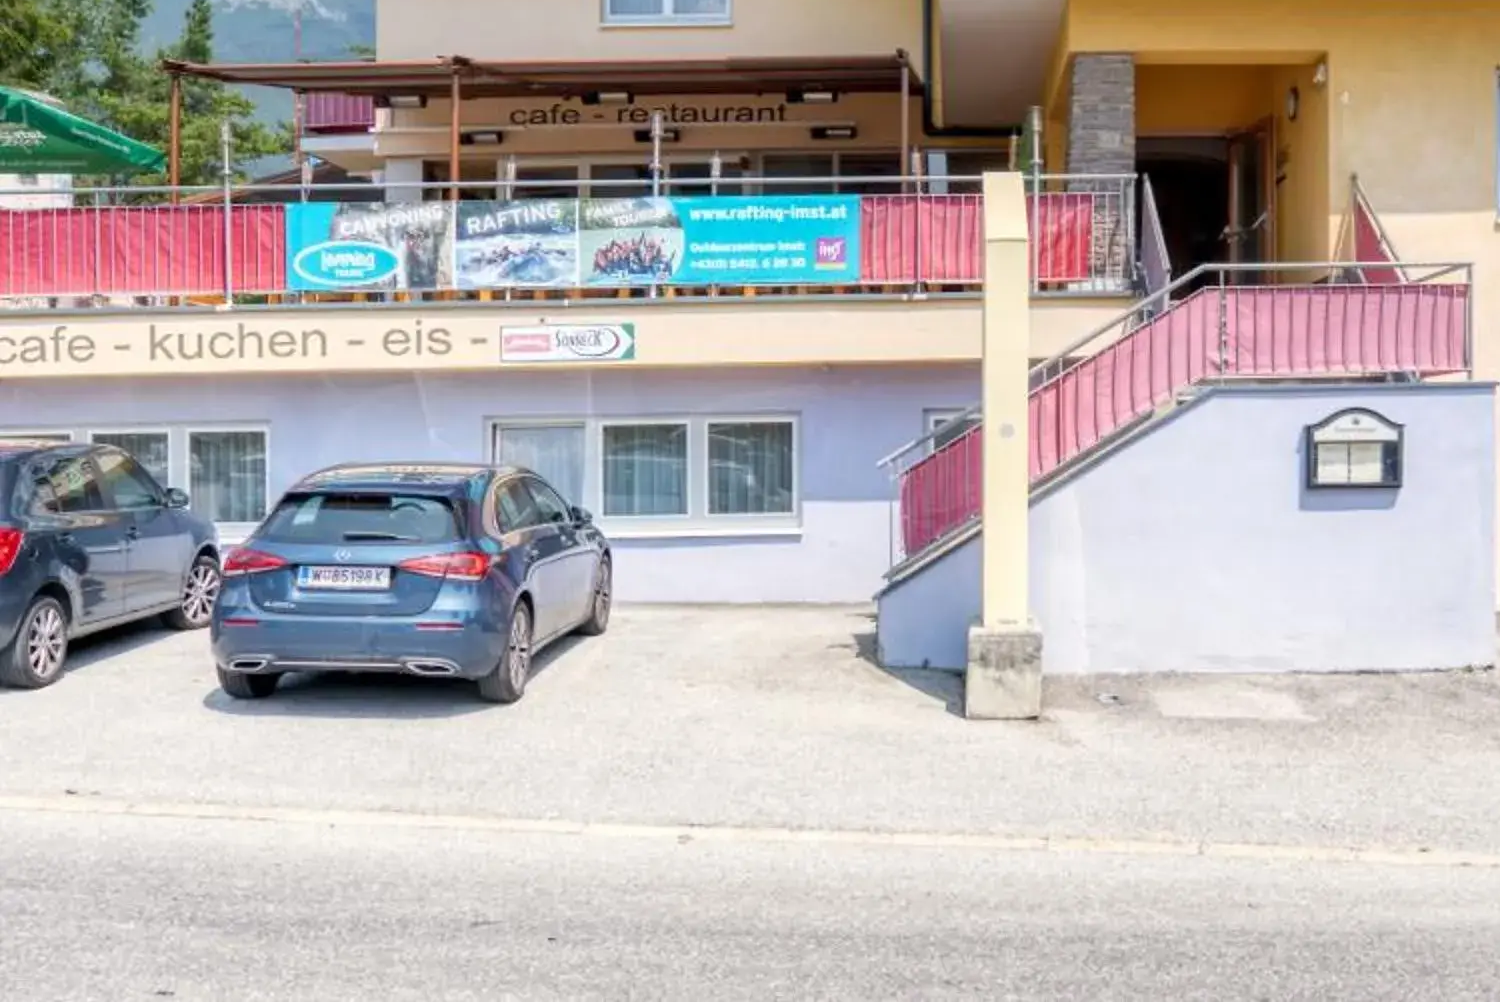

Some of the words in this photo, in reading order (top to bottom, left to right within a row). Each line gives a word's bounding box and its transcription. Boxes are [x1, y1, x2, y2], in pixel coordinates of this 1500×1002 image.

[509, 103, 581, 126] cafe
[467, 203, 561, 235] RAFTING
[689, 204, 847, 222] www.rafting-imst.at
[0, 326, 96, 364] cafe
[148, 323, 328, 361] kuchen
[382, 318, 453, 355] eis
